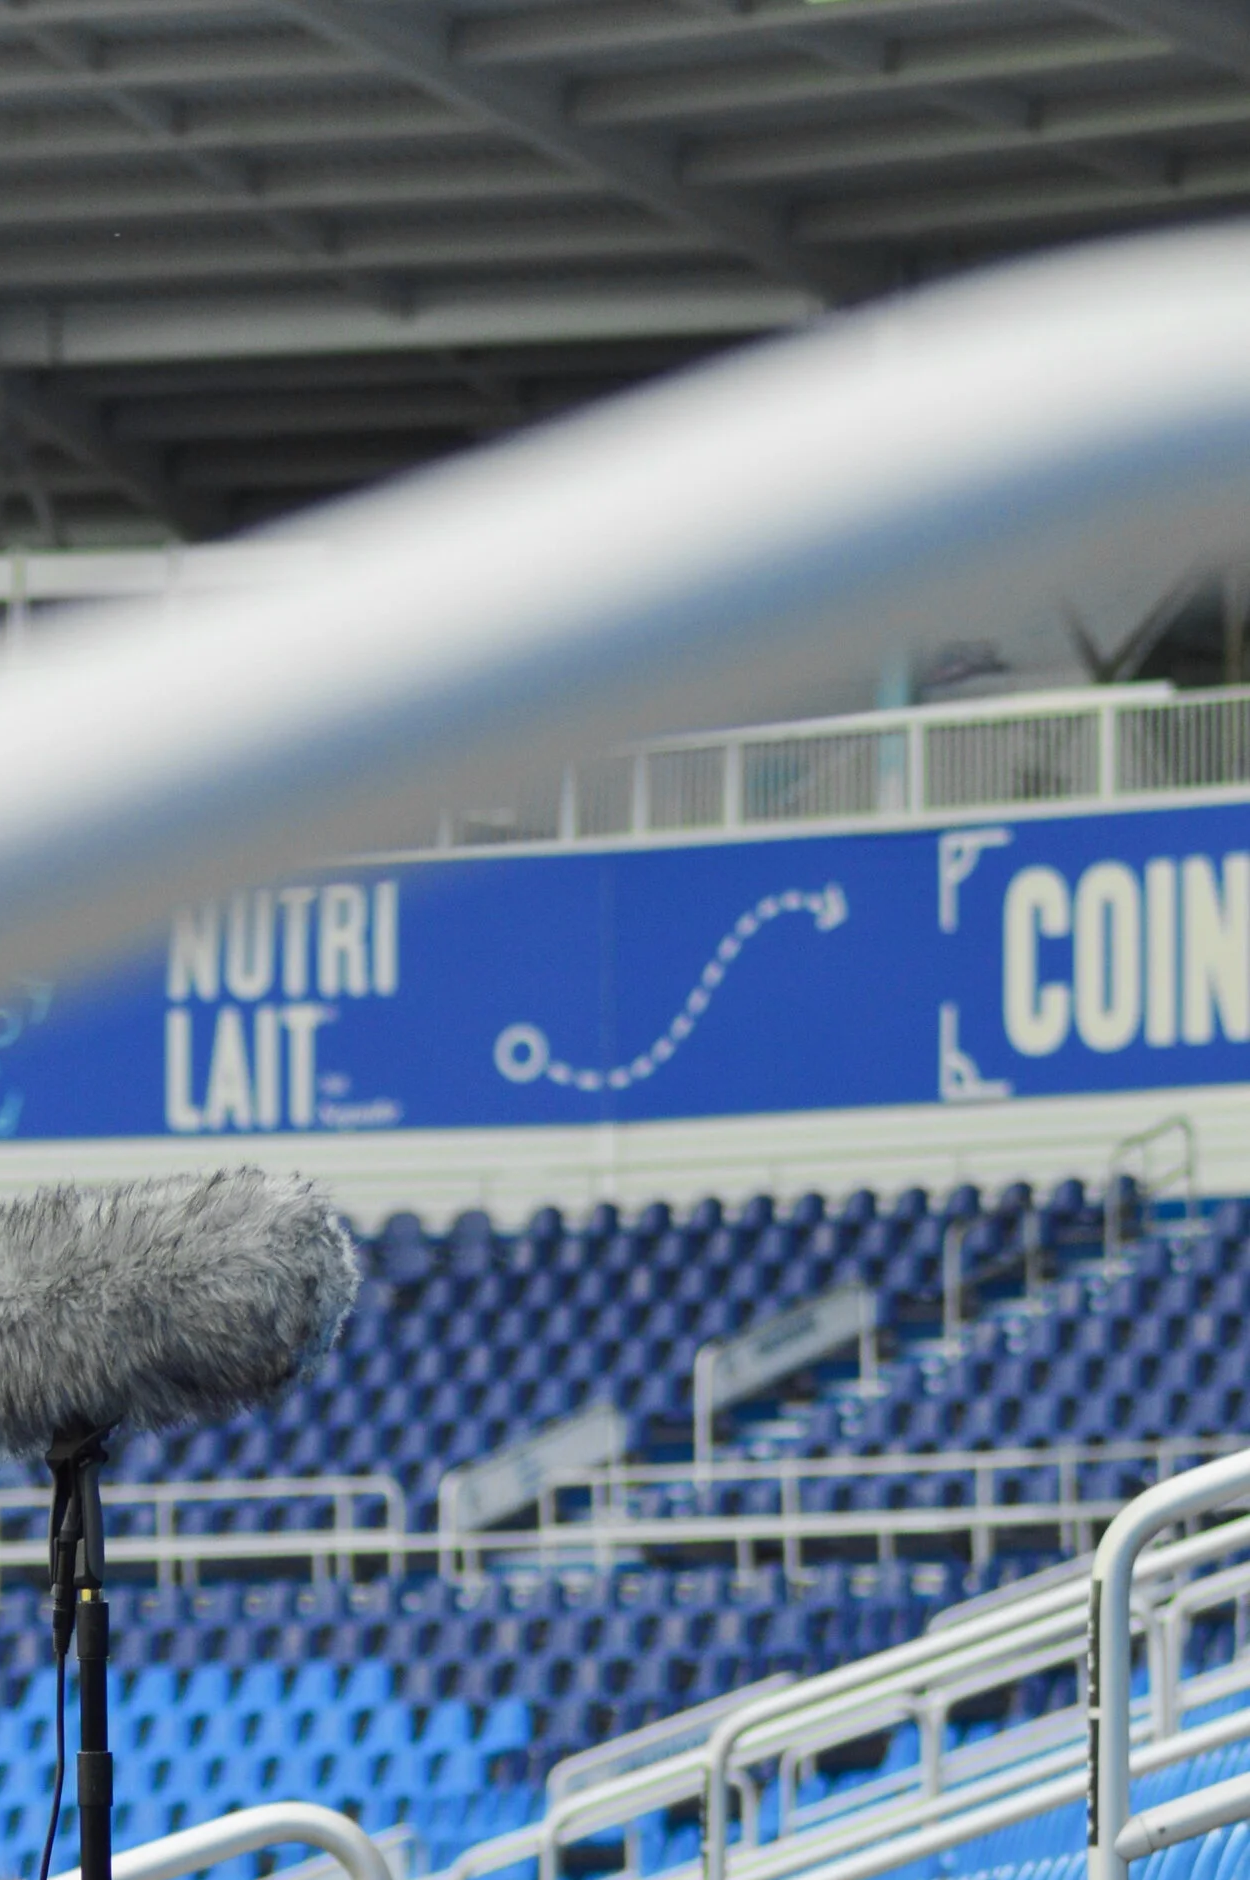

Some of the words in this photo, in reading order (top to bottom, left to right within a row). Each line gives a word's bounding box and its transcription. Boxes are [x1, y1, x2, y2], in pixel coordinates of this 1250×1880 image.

[168, 882, 397, 1000] NUTRI
[1004, 852, 1250, 1055] COIN
[167, 1005, 324, 1130] LAIT
